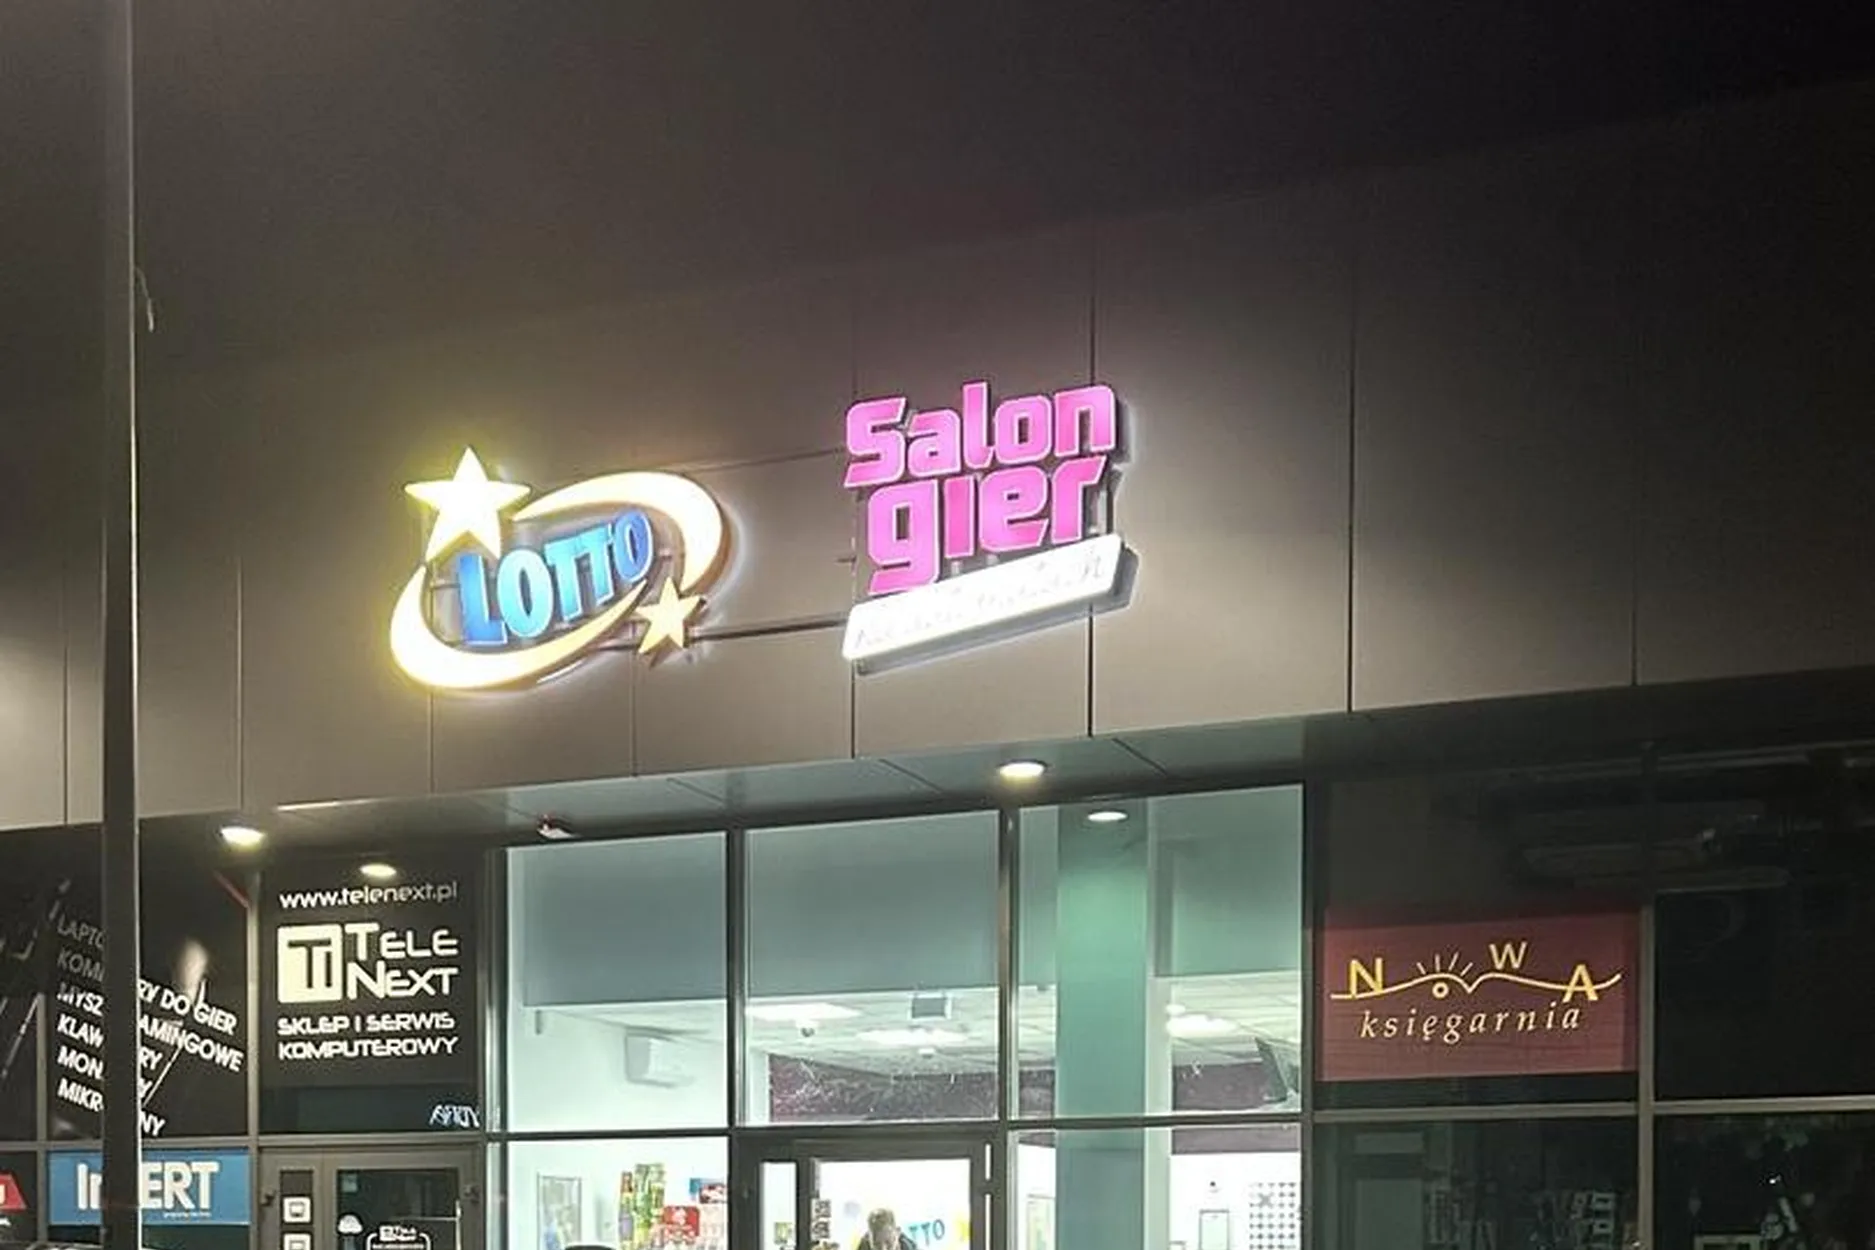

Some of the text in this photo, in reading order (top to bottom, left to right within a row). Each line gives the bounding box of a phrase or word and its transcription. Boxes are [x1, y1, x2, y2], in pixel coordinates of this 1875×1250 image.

[844, 379, 1116, 488] Salon
[866, 456, 1104, 593] gier
[455, 510, 653, 646] LOTTO
[279, 882, 458, 909] www.telenext.pl
[345, 922, 459, 961] TELE
[346, 961, 459, 1000] NEXT
[161, 989, 189, 1016] DO
[193, 1003, 238, 1035] GIER
[277, 1011, 455, 1036] SKLEP I SERWIS
[1361, 1001, 1582, 1044] księgarnia
[139, 1016, 245, 1072] AMINGOWE
[278, 1037, 459, 1060] KOMPUTEROWY
